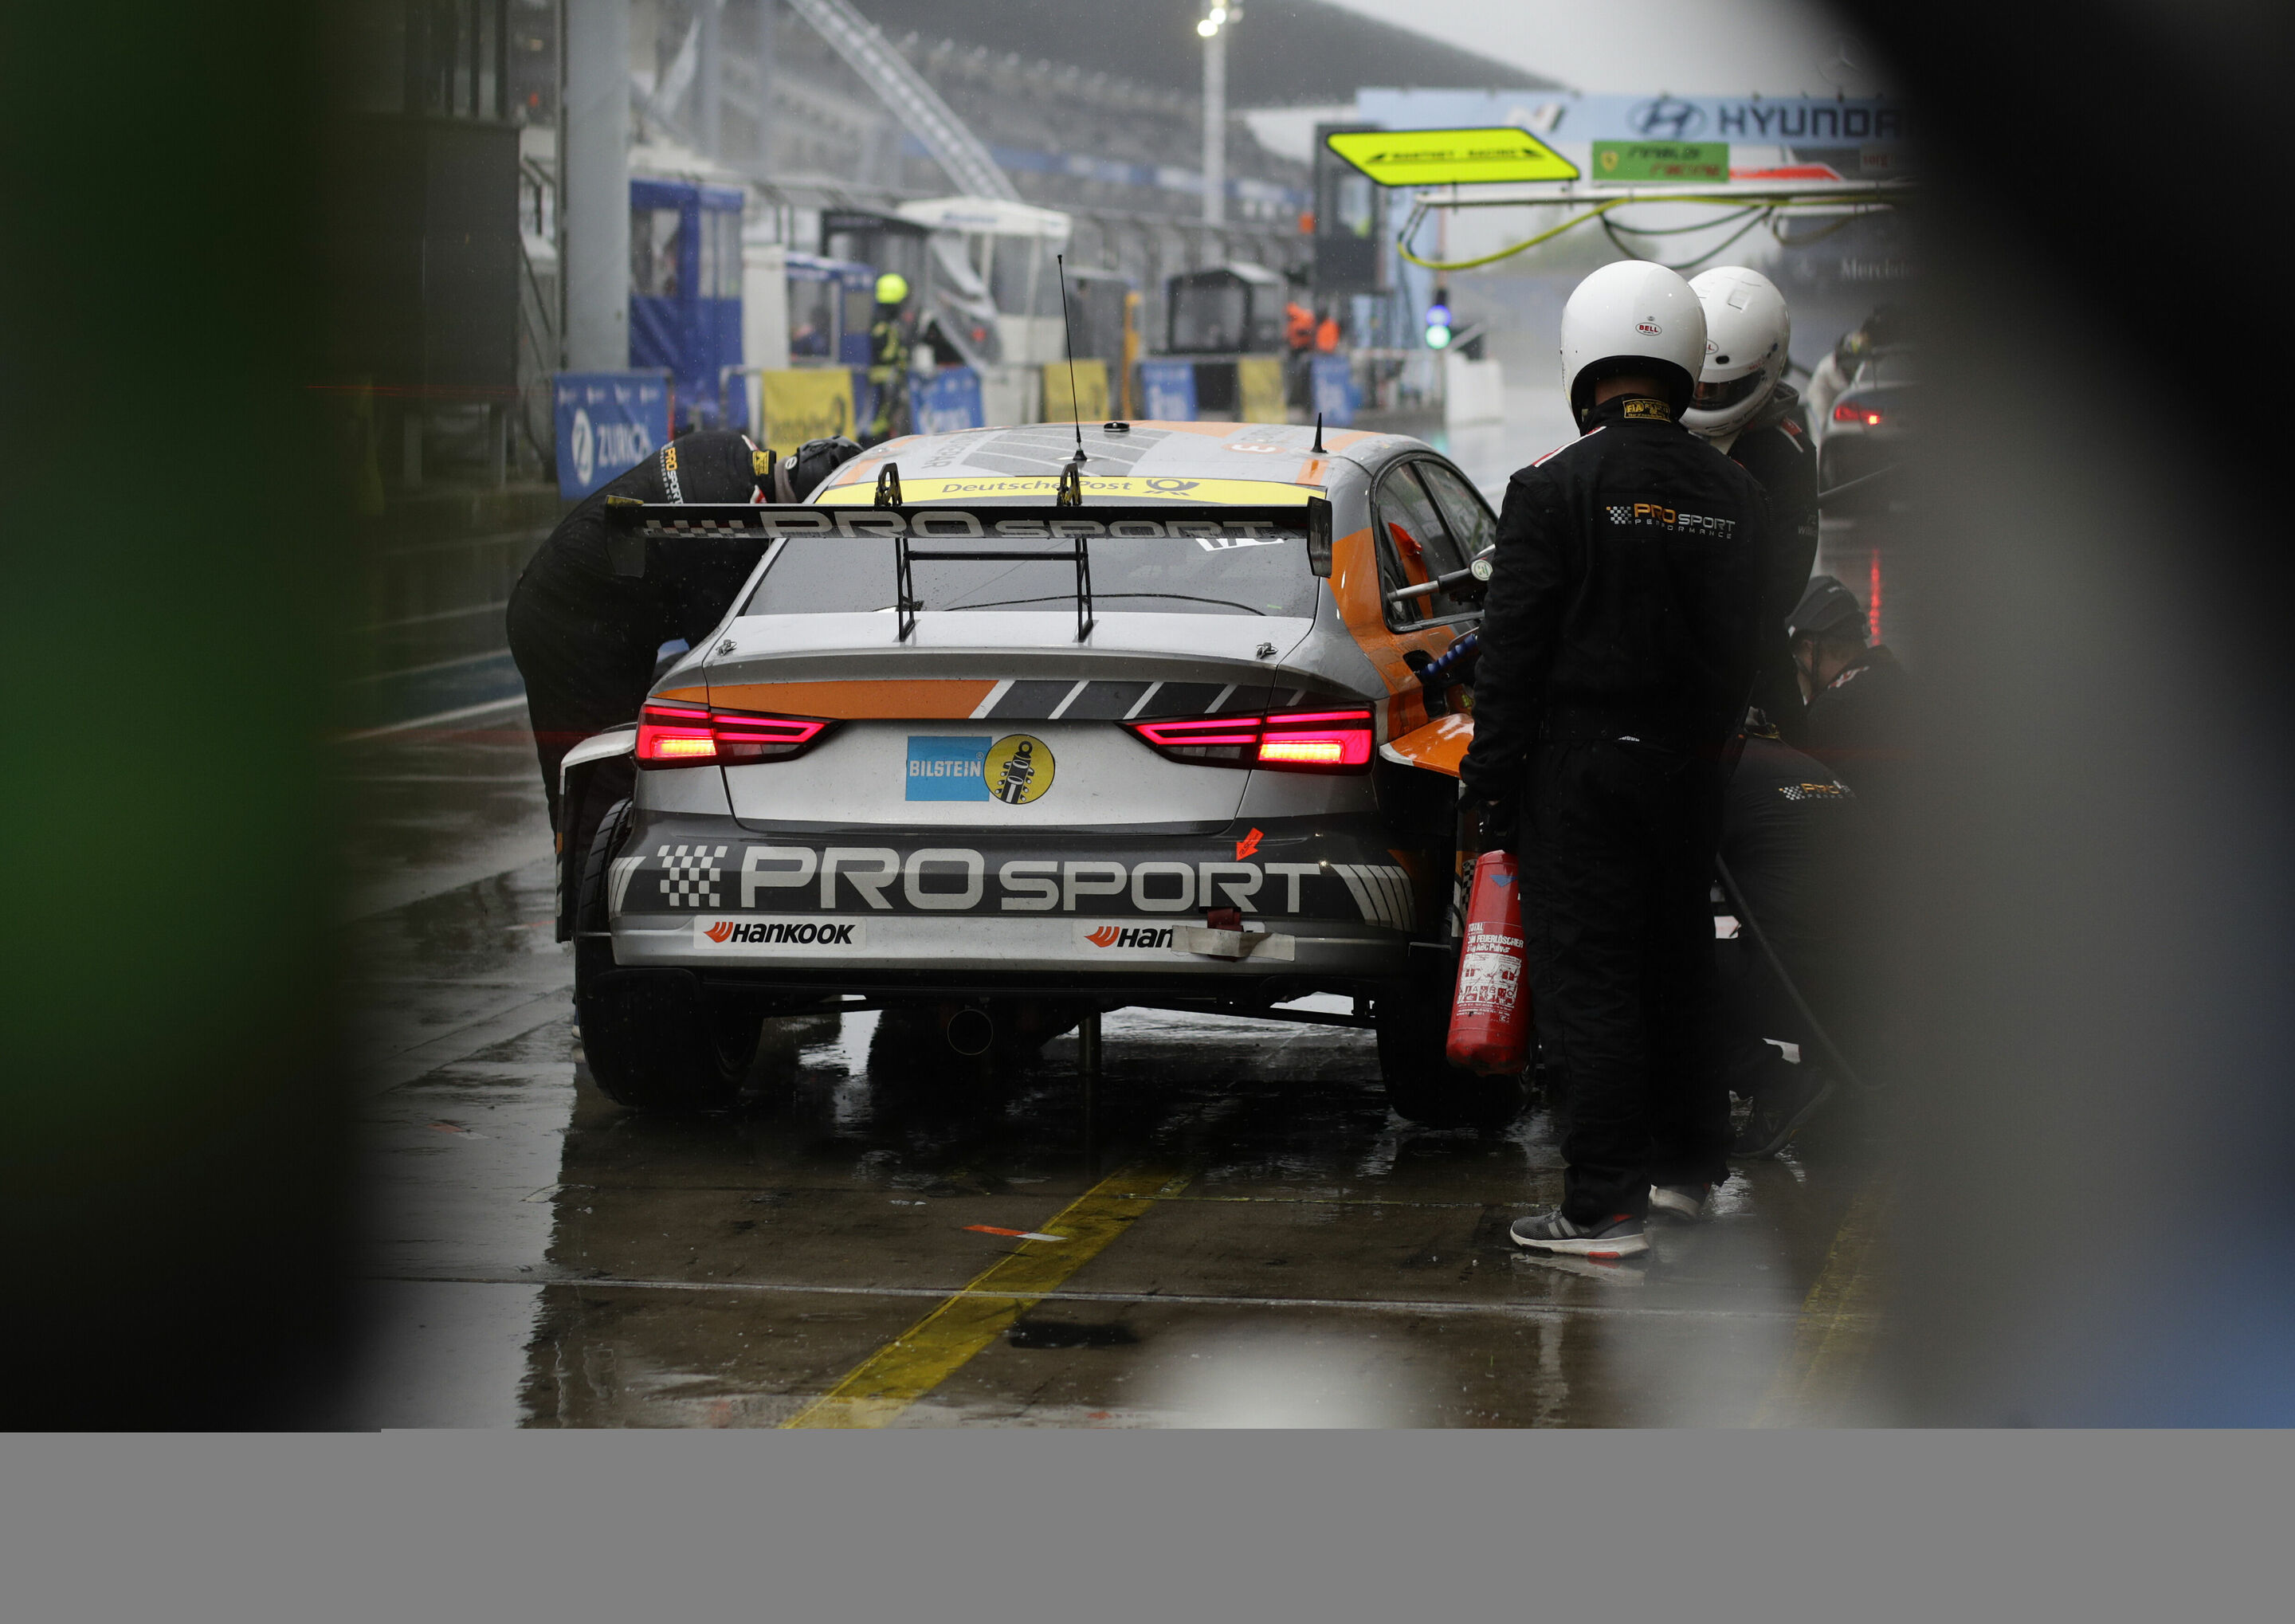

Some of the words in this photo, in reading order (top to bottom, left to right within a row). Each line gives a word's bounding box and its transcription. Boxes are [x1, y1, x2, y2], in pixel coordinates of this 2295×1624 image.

[1717, 104, 1904, 139] HYUNDA
[1639, 324, 1658, 333] BELL
[665, 447, 678, 471] PRO
[942, 480, 1061, 493] Deutsche
[759, 511, 985, 538] PRO
[995, 520, 1274, 539] SPORT
[1634, 519, 1732, 539] PERFORMANCE
[909, 759, 982, 777] BILSTEIN
[740, 845, 984, 909] PRO
[999, 861, 1321, 913] SPORT
[1477, 934, 1524, 948] FEUERLÖSCHER
